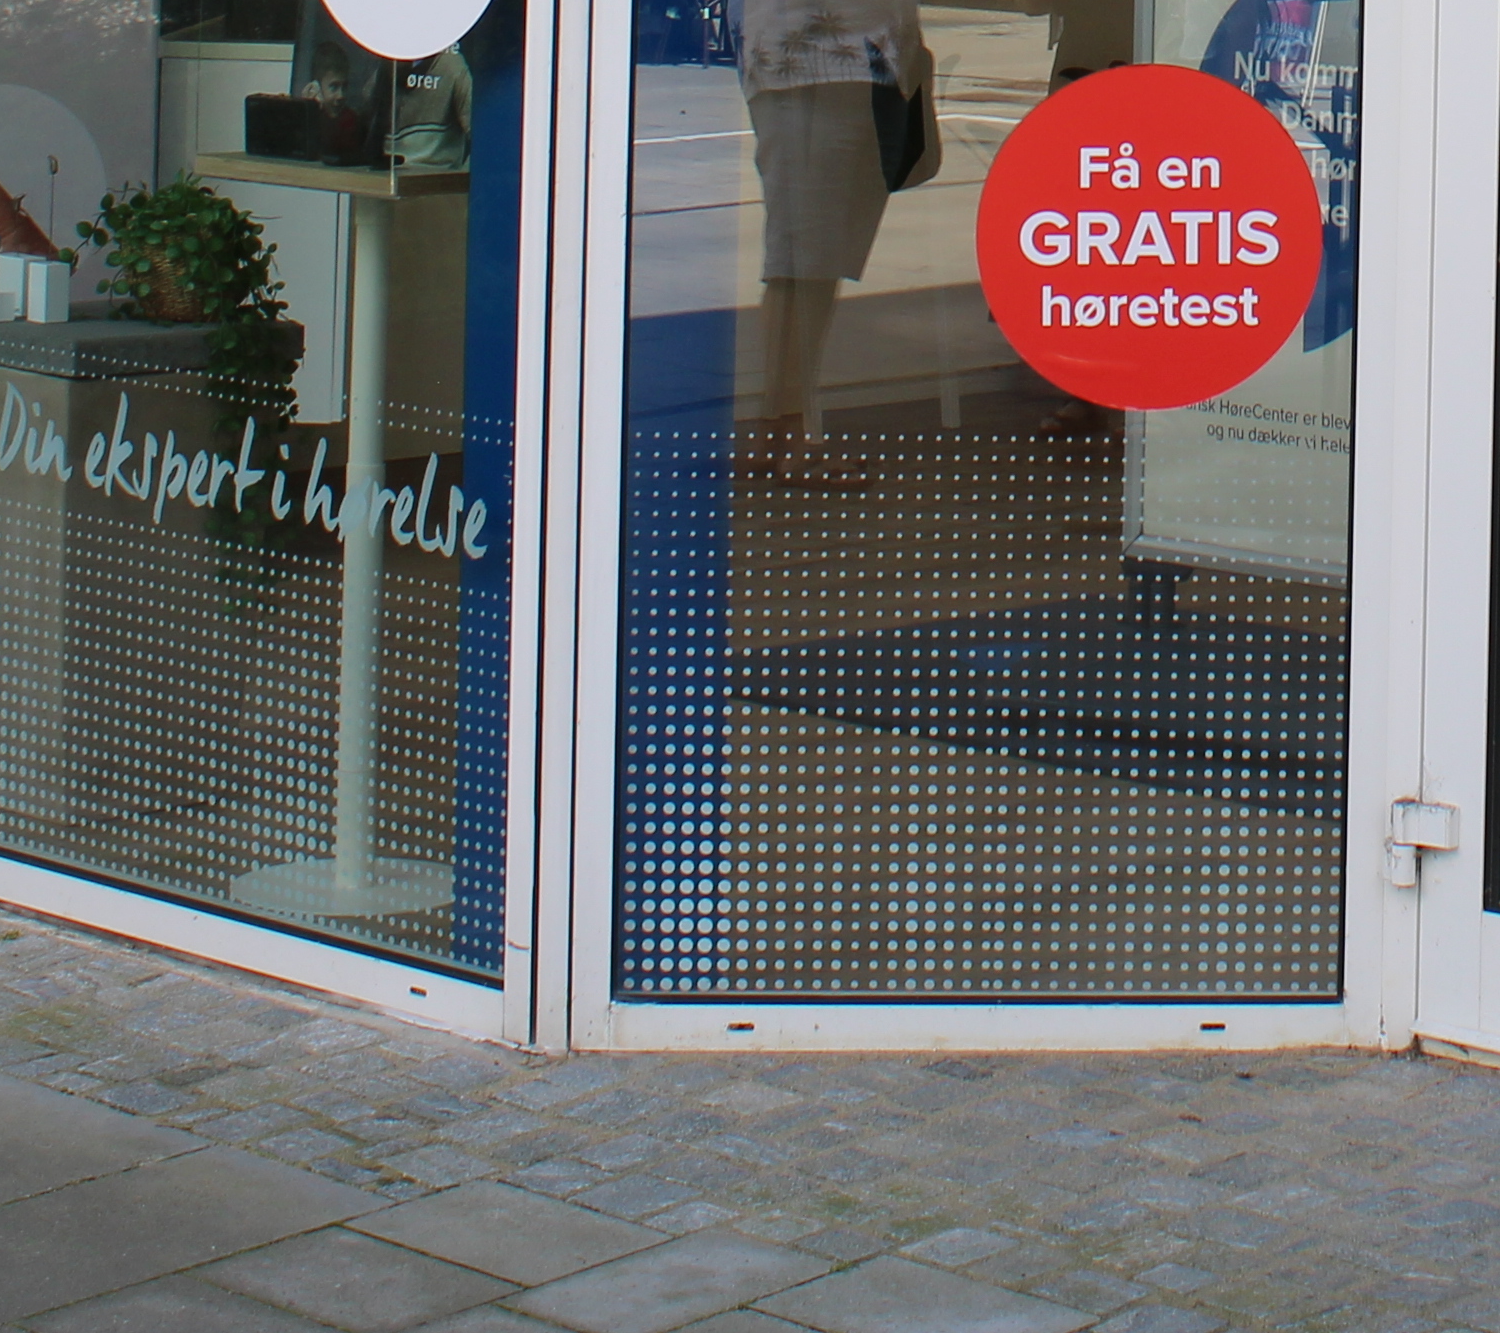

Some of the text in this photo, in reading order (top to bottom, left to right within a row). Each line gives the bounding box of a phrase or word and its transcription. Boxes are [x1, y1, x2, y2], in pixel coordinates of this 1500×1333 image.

[406, 70, 441, 90] ører
[1234, 51, 1270, 82] Nu
[1079, 142, 1222, 190] Få en
[1019, 209, 1281, 267] GRATIS
[1041, 285, 1260, 327] høretest
[1219, 399, 1299, 425] HøreCenter
[1303, 412, 1318, 426] er
[1322, 411, 1350, 431] blev
[1206, 424, 1224, 441] og
[1228, 426, 1245, 440] nu
[1248, 427, 1302, 448] dækker
[84, 390, 266, 525] ekspert
[270, 443, 292, 521] i
